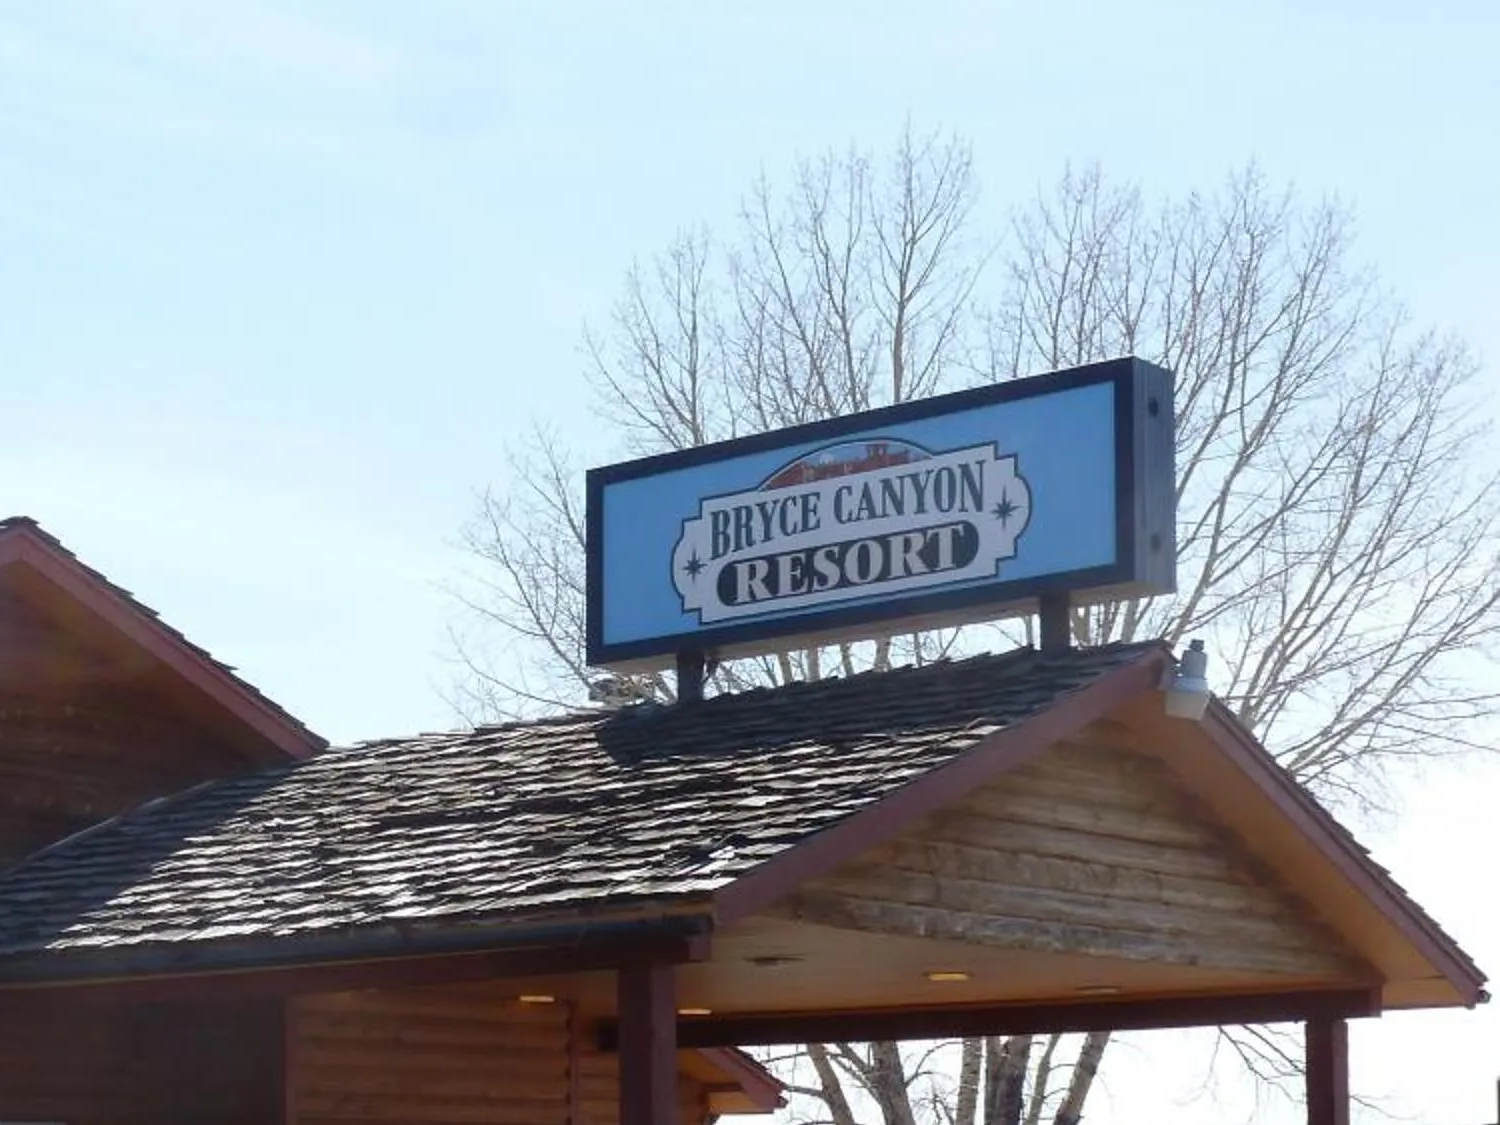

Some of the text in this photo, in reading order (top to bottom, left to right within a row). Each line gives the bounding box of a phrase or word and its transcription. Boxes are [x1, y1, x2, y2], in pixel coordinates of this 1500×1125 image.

[711, 461, 985, 559] BRYCE CANYON
[735, 526, 965, 603] RESORT
